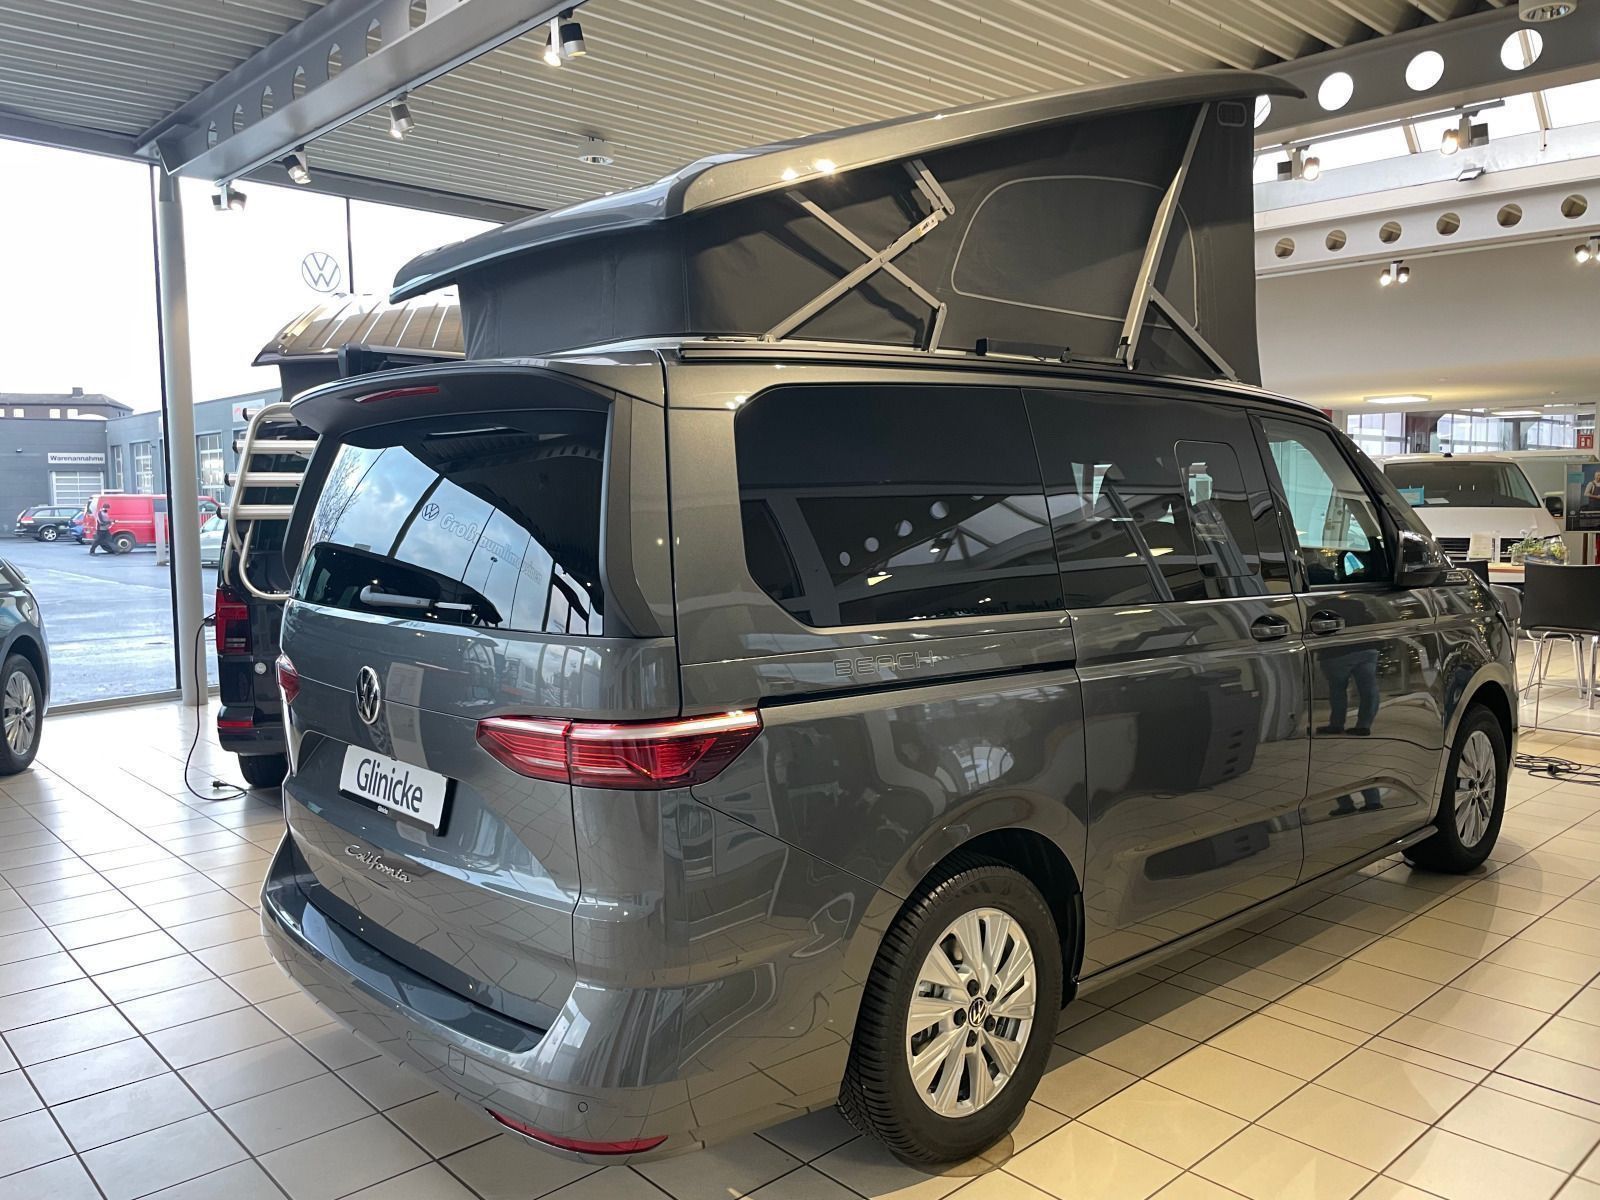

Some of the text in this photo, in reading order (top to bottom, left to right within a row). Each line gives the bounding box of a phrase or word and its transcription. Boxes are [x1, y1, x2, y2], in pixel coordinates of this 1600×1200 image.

[833, 650, 936, 678] BEACH
[357, 758, 423, 813] Glinicke
[344, 844, 412, 883] California
